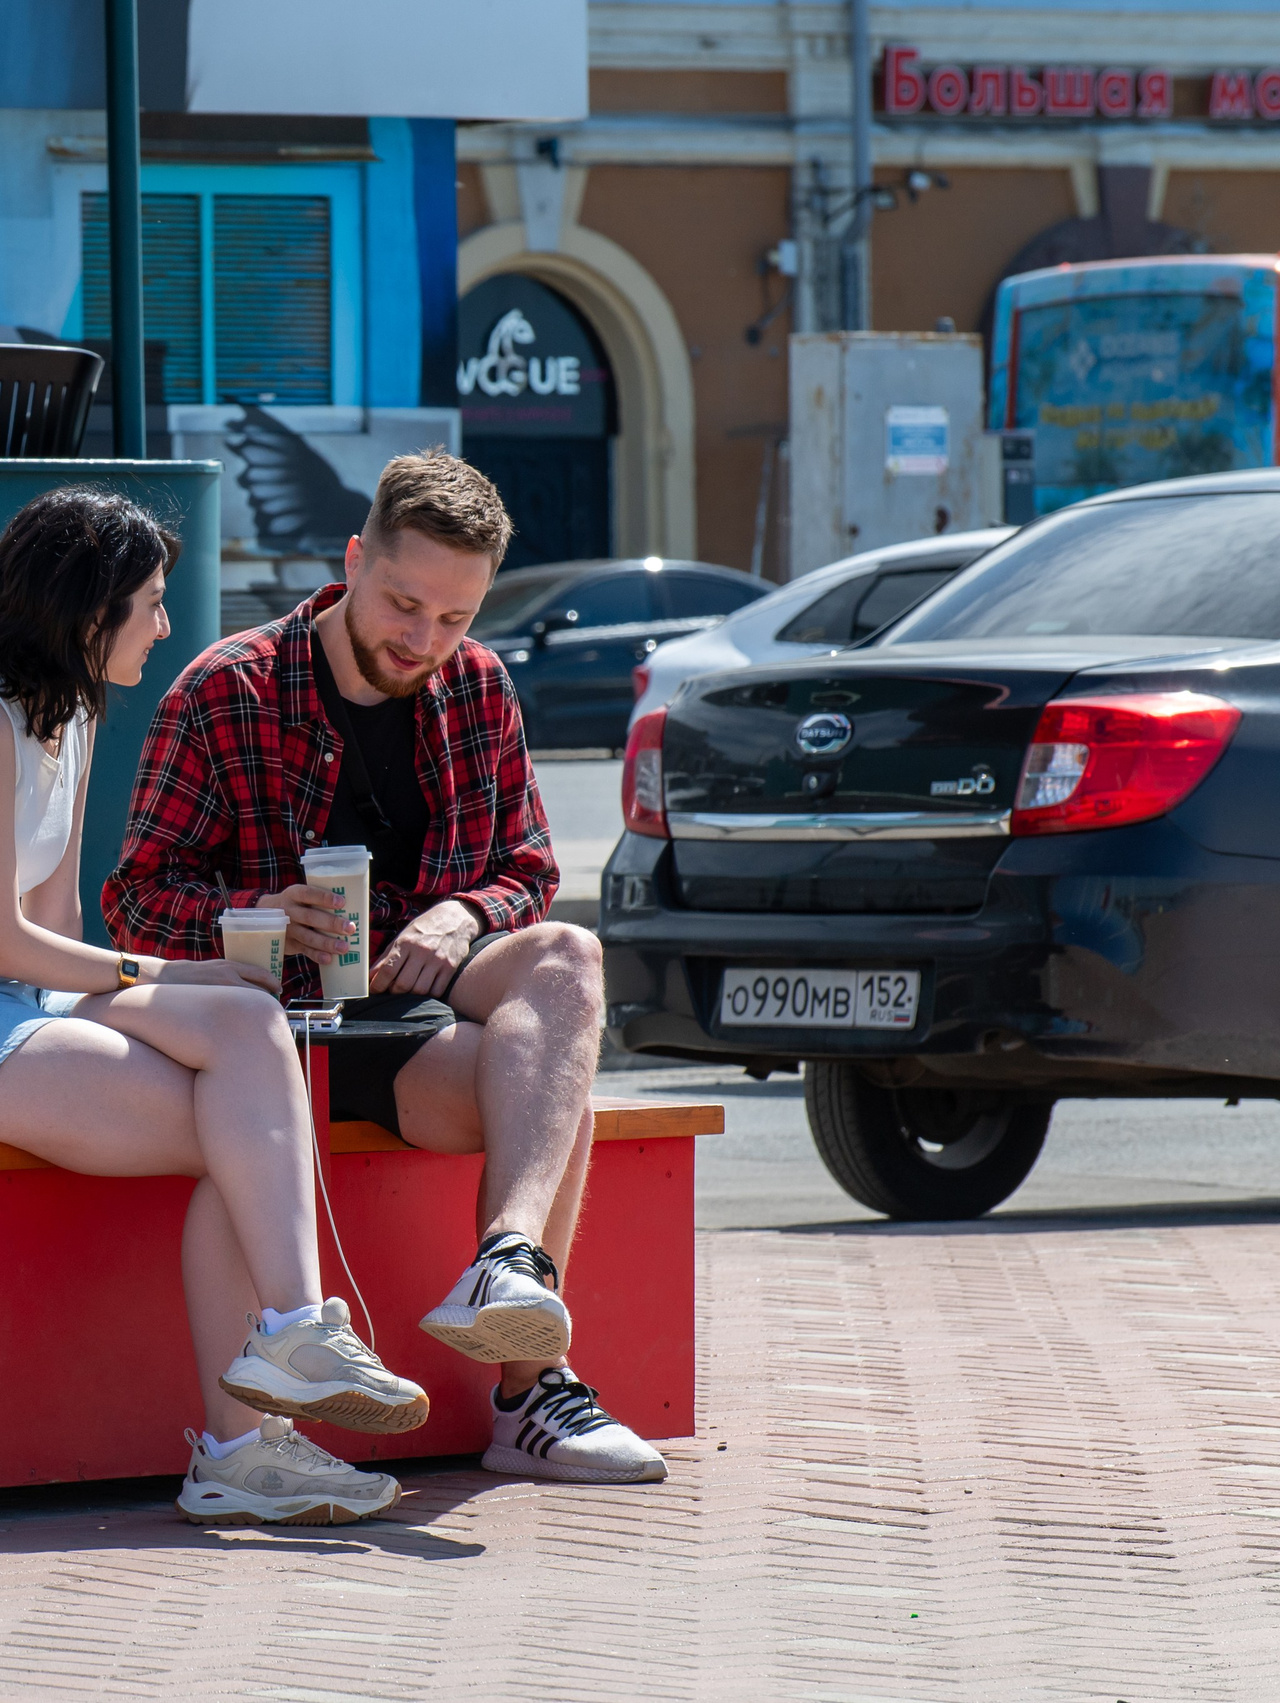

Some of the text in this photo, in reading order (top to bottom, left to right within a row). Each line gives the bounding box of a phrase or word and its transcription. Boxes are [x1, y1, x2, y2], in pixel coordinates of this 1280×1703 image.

[885, 45, 1280, 120] Большая мо
[800, 727, 845, 739] DATSUN
[270, 939, 280, 977] OFFEE
[731, 975, 908, 1019] О990МВ 152
[869, 1008, 893, 1023] RUS
